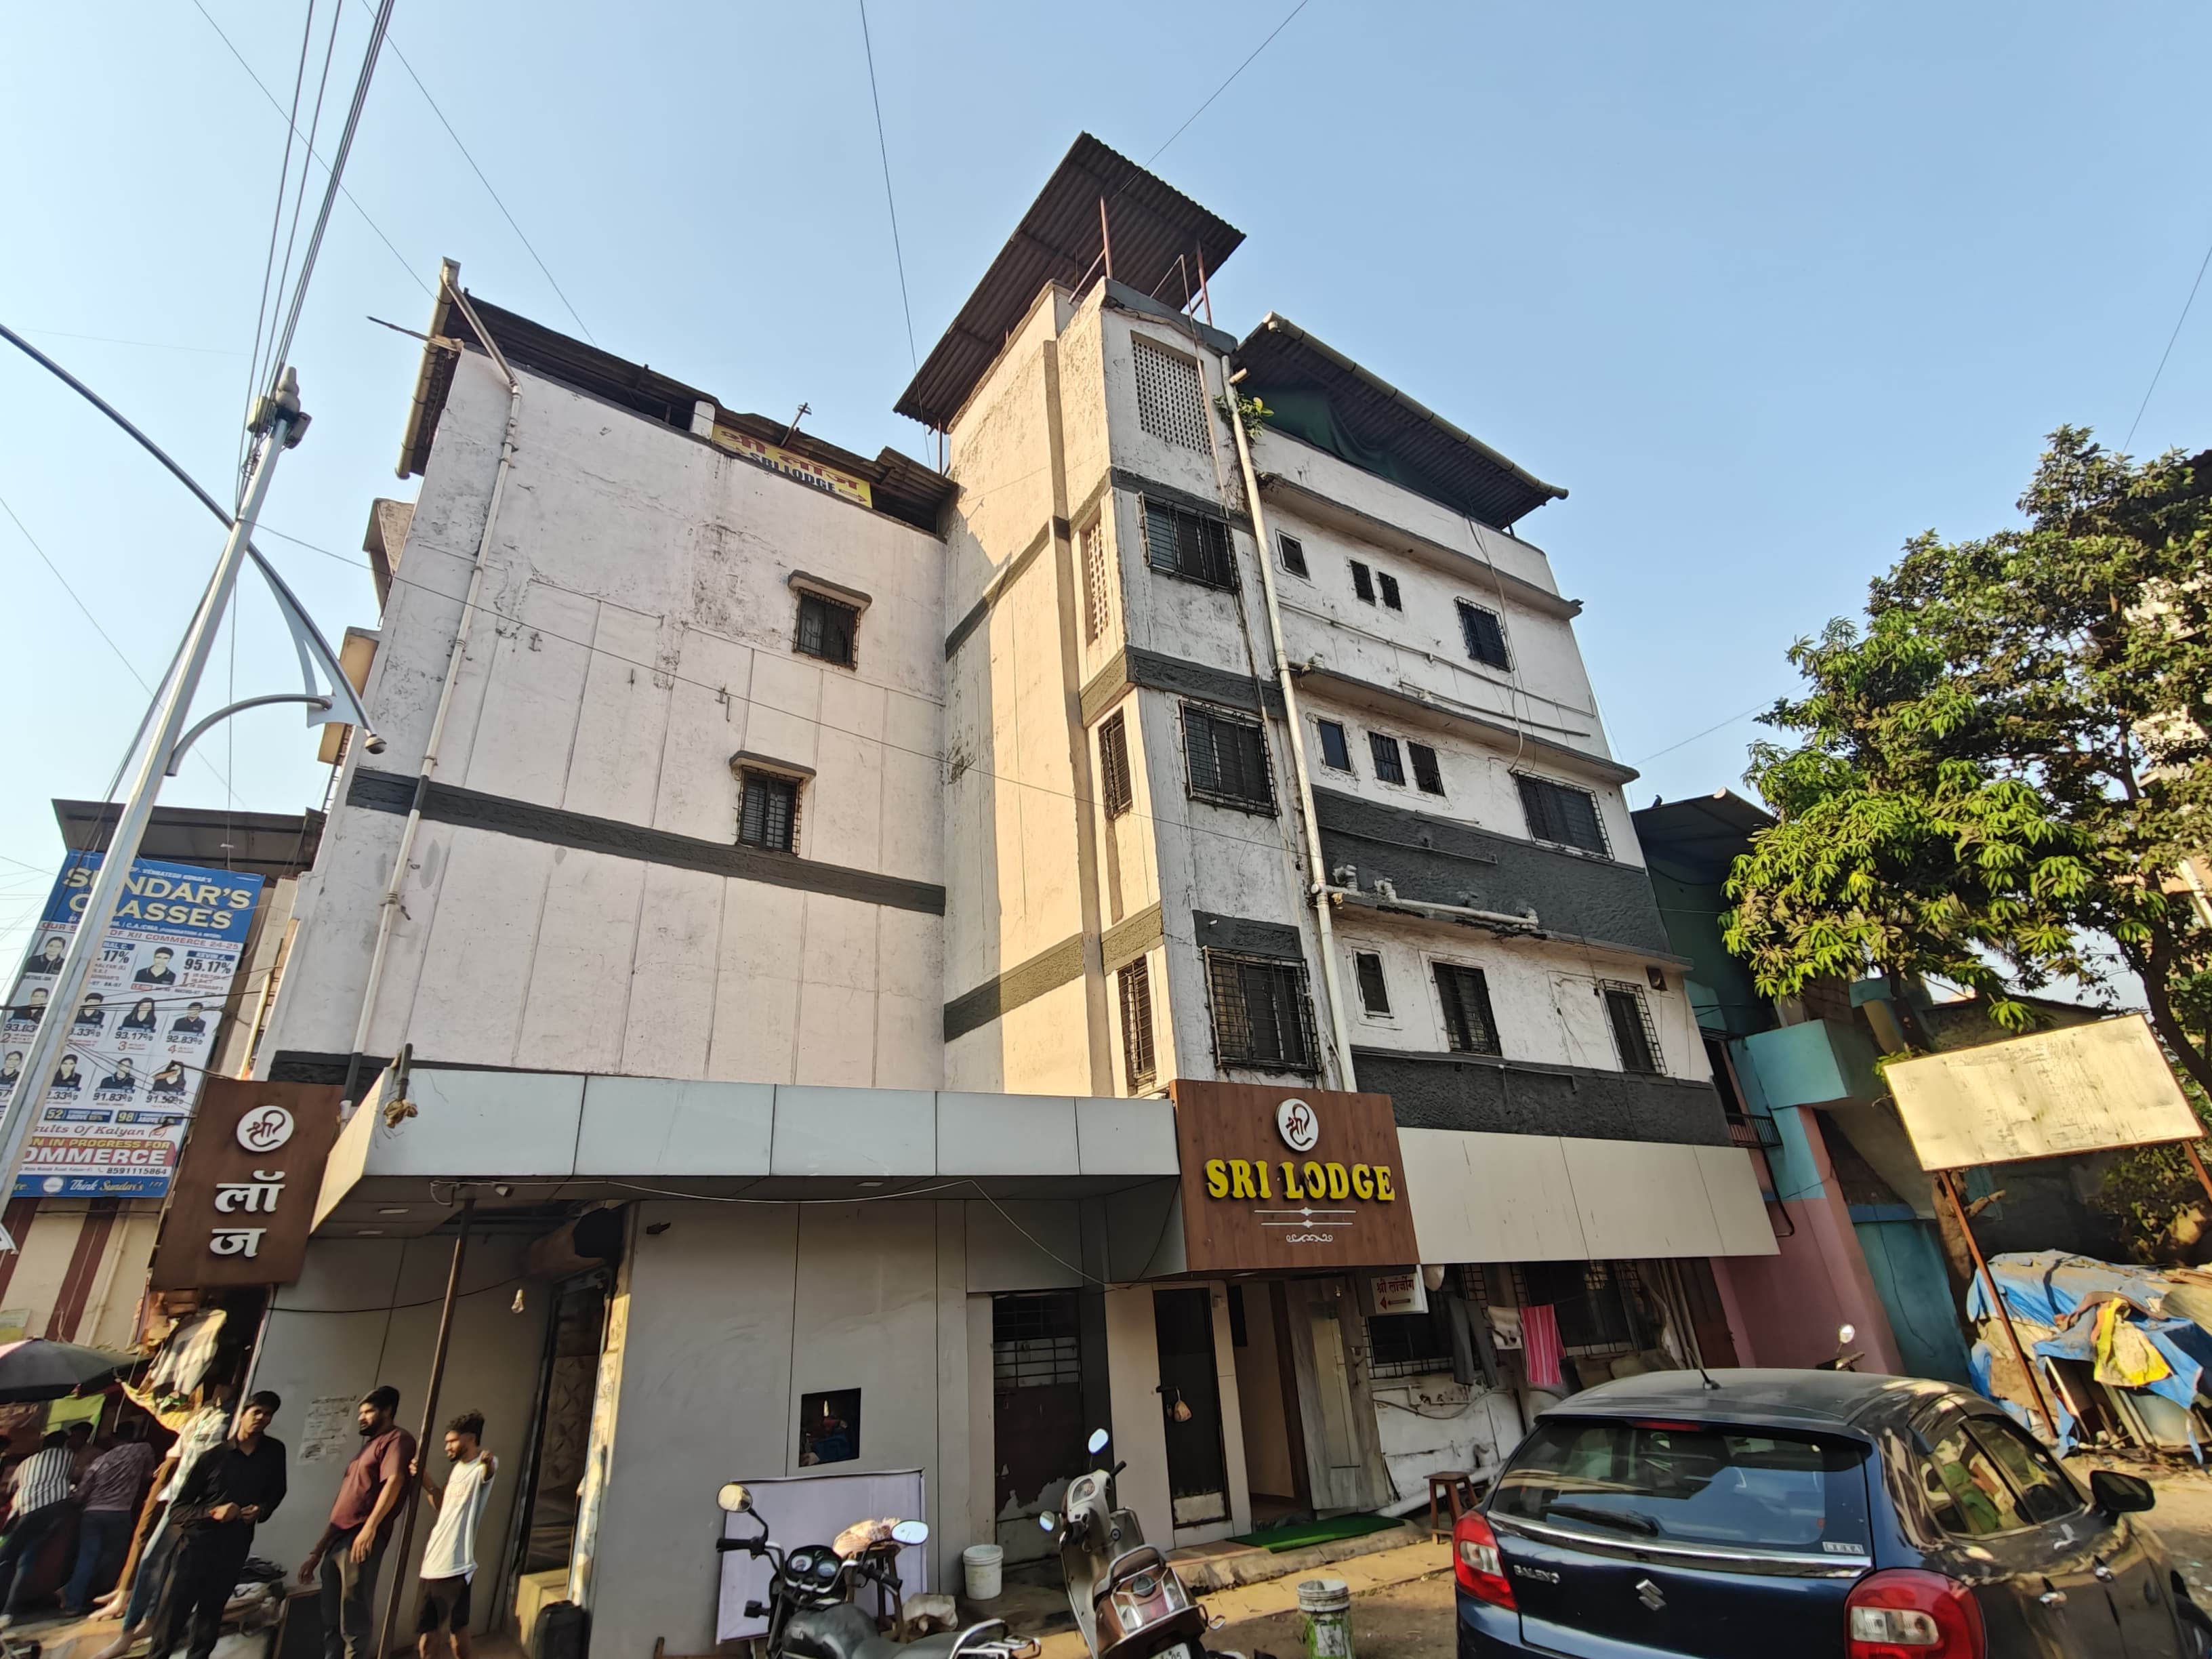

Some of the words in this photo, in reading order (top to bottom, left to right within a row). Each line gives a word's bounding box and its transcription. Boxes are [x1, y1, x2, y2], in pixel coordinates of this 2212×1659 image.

[783, 465, 836, 493] LODGE
[69, 893, 234, 930] CASSES
[42, 922, 66, 930] OUR
[146, 933, 207, 947] COMMERCE
[209, 940, 239, 949] 24-25
[184, 958, 232, 975] 95.17%
[115, 1031, 153, 1041] 93.17%
[93, 1092, 133, 1103] 91.83%
[47, 1109, 64, 1120] 52
[118, 1111, 134, 1122] 98
[33, 1124, 69, 1134] sults
[74, 1125, 91, 1136] Of
[94, 1126, 145, 1136] Kalyan
[49, 1138, 65, 1147] IN
[69, 1139, 142, 1149] PROGRESS
[144, 1141, 171, 1150] FOR
[25, 1147, 167, 1165] OMMERCE
[69, 1179, 99, 1191] Think
[1204, 1159, 1272, 1199] SRI
[1279, 1161, 1396, 1202] LODGE
[1513, 1565, 1561, 1584] BALENO
